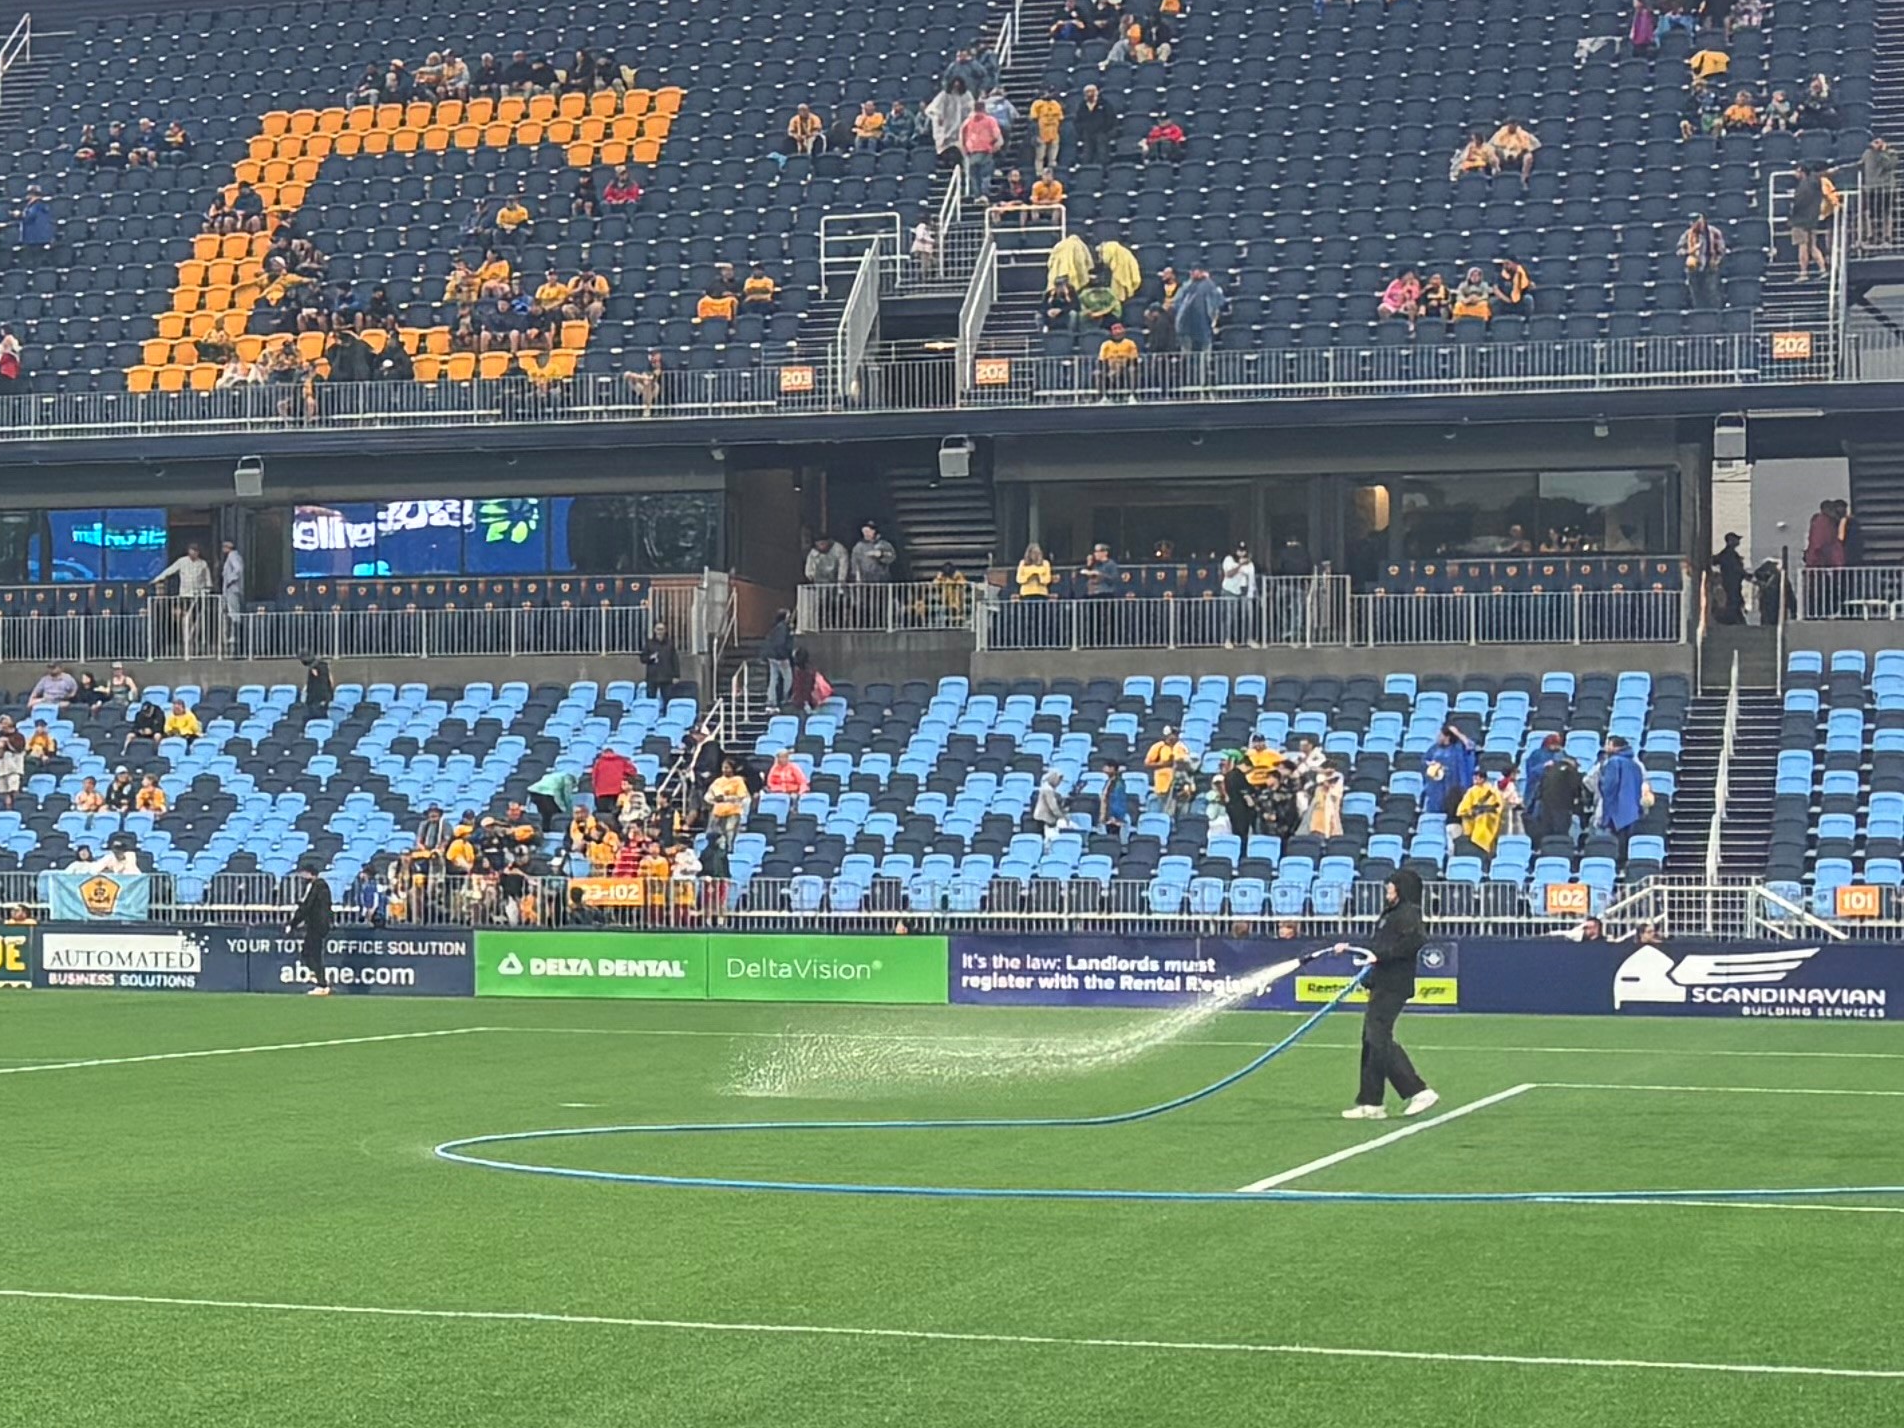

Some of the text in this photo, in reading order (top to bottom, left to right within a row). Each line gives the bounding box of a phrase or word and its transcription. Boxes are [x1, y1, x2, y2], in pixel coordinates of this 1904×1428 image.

[1775, 338, 1809, 352] 202
[782, 373, 811, 385] 203
[976, 364, 1008, 379] 202
[1549, 889, 1586, 906] 102
[1843, 892, 1874, 909] 101
[226, 938, 270, 954] YOUR
[326, 939, 383, 955] OFFICE
[387, 940, 466, 956] SOLUTION
[50, 949, 195, 969] AUTOMATED
[530, 958, 685, 977] DELTA DENTAL
[962, 953, 1216, 973] It's the law: Landlords must
[48, 973, 196, 988] BUSINESS SOLUTIONS
[280, 960, 414, 985] abne.com
[961, 972, 1034, 992] register
[1038, 972, 1078, 989] with
[1084, 973, 1115, 990] the
[1119, 974, 1181, 991] Rental
[1691, 987, 1886, 1005] SCANDINAVIAN
[1742, 1006, 1886, 1018] BUILDING SERVICES
